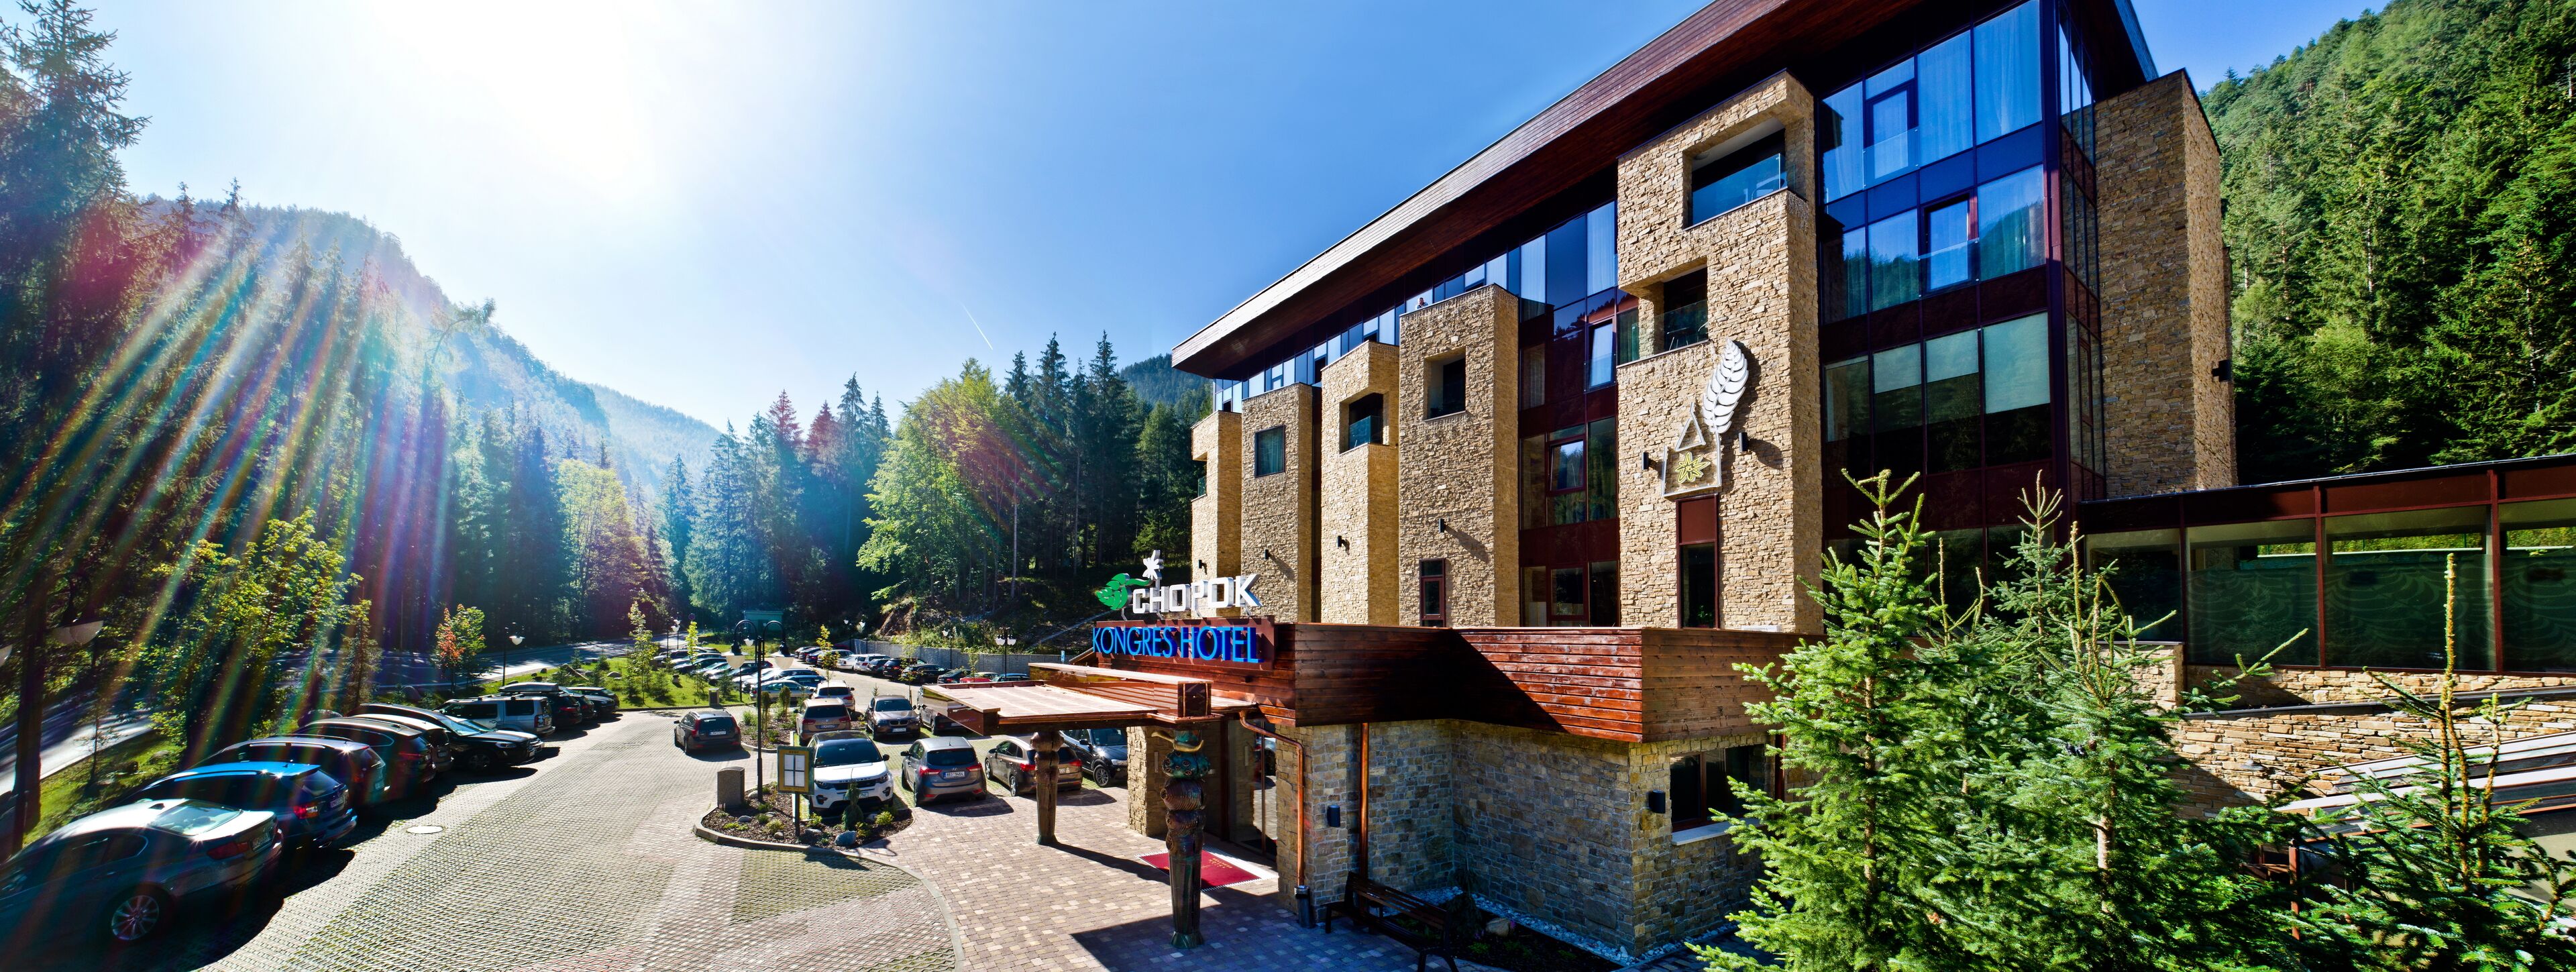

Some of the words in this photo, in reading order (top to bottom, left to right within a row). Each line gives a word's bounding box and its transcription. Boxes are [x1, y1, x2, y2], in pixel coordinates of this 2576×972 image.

[1132, 574, 1263, 614] CHOPOK
[1093, 627, 1176, 657] KONGRES
[1180, 625, 1263, 663] HOTEL
